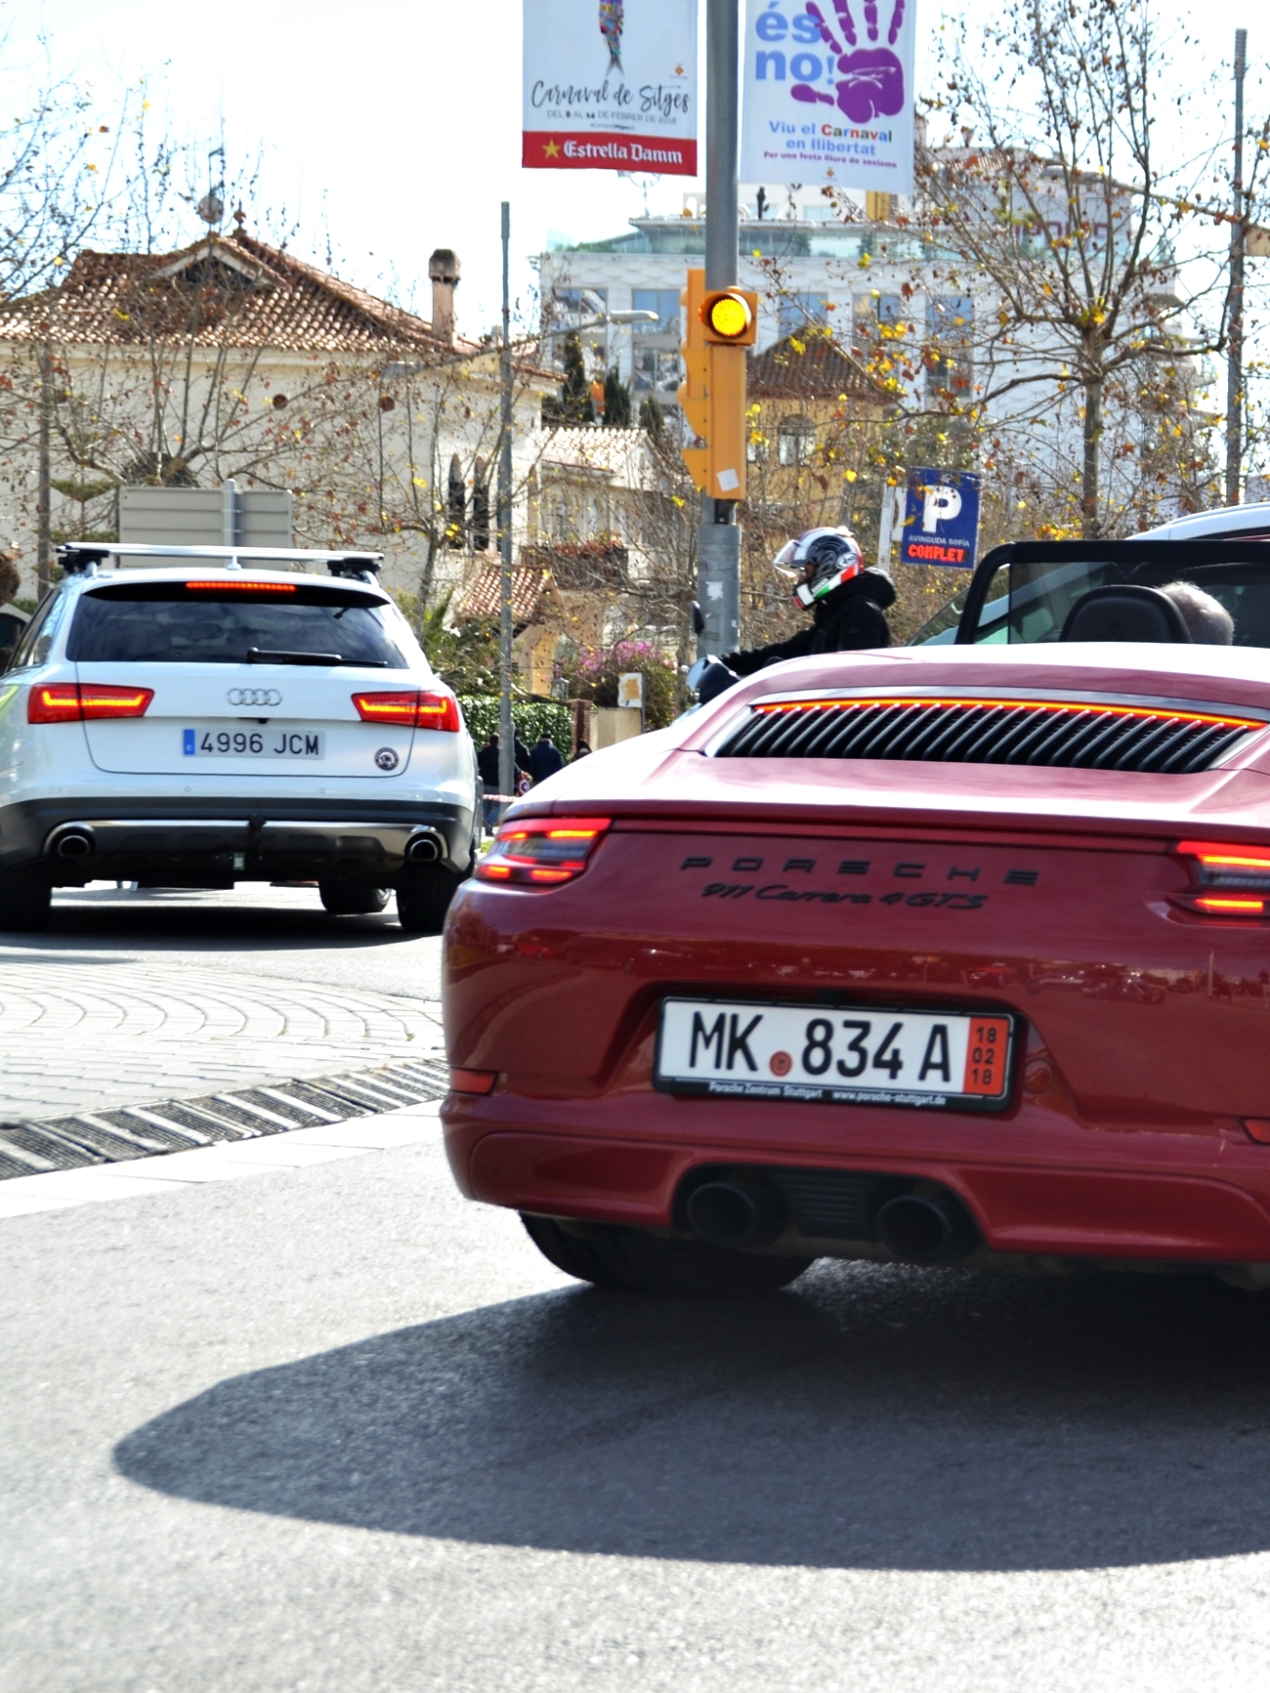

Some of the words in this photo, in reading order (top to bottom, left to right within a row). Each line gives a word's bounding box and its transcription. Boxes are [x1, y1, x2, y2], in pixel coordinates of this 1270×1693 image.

[756, 1, 822, 44] és
[755, 50, 835, 85] no!
[531, 79, 609, 107] Carnaval
[613, 83, 632, 106] de
[639, 84, 690, 117] Sitges
[547, 110, 563, 119] DEL
[573, 111, 584, 119] AL
[597, 110, 609, 119] DE
[611, 111, 643, 122] FEBRER
[645, 114, 657, 124] DE
[657, 116, 677, 125] 2018
[769, 120, 795, 134] Viu
[801, 122, 816, 135] el
[821, 124, 892, 142] Carnaval
[563, 140, 628, 159] Estrella
[630, 143, 683, 164] Damm
[786, 138, 805, 149] en
[811, 139, 876, 155] llibertat
[764, 151, 778, 159] Per
[799, 152, 822, 161] festa
[849, 155, 860, 164] de
[862, 158, 897, 168] sexisme
[922, 485, 962, 534] P
[908, 535, 947, 545] AVINGUDA
[907, 544, 965, 563] COMPLET
[200, 732, 264, 753] 4996
[274, 733, 319, 755] JCM
[681, 855, 1039, 886] PORSCHE
[702, 882, 755, 899] 911
[756, 883, 872, 905] Carrera
[879, 891, 904, 905] 4
[905, 892, 990, 910] GTS
[689, 1010, 764, 1073] MK
[802, 1018, 904, 1080] 834
[918, 1023, 951, 1083] A
[976, 1026, 997, 1044] 18
[972, 1047, 995, 1066] 02
[971, 1068, 993, 1086] 18
[708, 1081, 744, 1095] Porsche
[744, 1084, 781, 1097] Zentrum
[783, 1085, 823, 1101] Stuttgart
[832, 1088, 947, 1107] www.porsche-stuttgart.de
